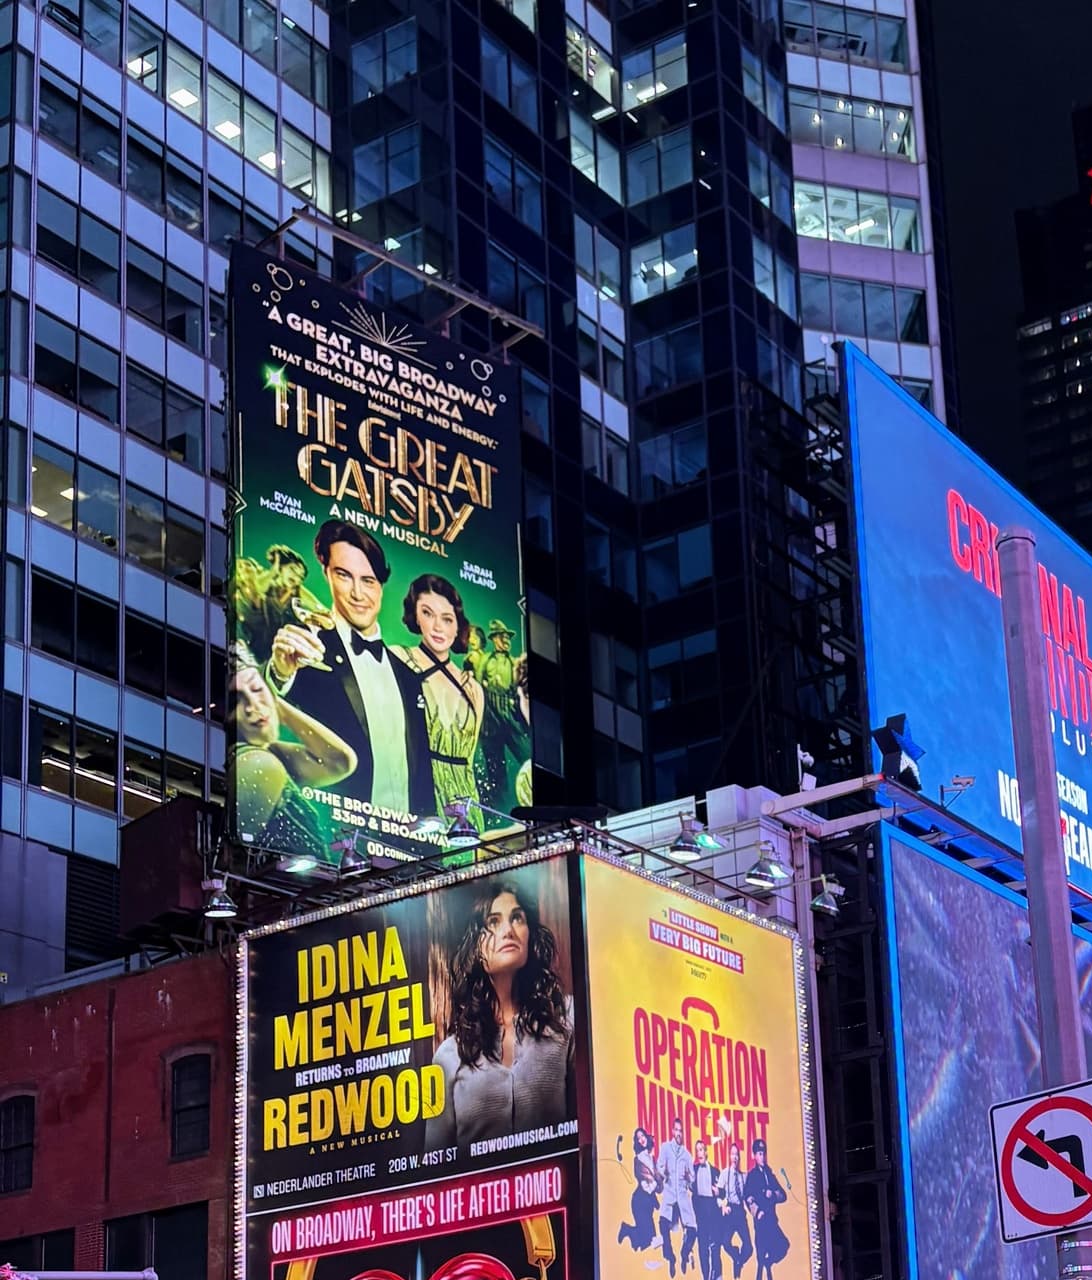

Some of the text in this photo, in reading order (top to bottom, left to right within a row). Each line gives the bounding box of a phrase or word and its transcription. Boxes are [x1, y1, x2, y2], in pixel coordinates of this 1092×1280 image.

[270, 345, 302, 367] THAT
[305, 360, 367, 395] EXPLODES
[368, 386, 399, 407] WITH
[401, 400, 424, 419] LIFE
[425, 412, 450, 430] AND
[286, 313, 355, 357] GREAT,
[360, 344, 394, 372] BIG
[398, 361, 497, 417] BROADWAY
[316, 344, 463, 422] EXTRAVAGANZA
[272, 380, 498, 509] THE GREAT
[260, 497, 315, 525] McCARTAN
[273, 490, 301, 509] RYAN
[297, 443, 474, 543] GATSBY
[329, 504, 449, 558] A NEW MUSICAL
[460, 569, 497, 590] HYLAND
[463, 561, 493, 579] SARAH
[313, 789, 418, 825] THE BROADWAY
[331, 808, 451, 848] 53RD & BROADWAY
[999, 770, 1021, 826] NO
[297, 926, 408, 1004] IDINA
[652, 923, 680, 947] VERY
[682, 934, 701, 956] BIG
[702, 941, 742, 971] FUTURE
[274, 982, 436, 1071] MENZEL
[634, 1007, 768, 1108] OPERATION
[295, 1064, 342, 1088] RETURNS
[355, 1048, 411, 1075] BROADWAY
[263, 1064, 446, 1152] REDWOOD
[266, 1120, 579, 1196] NEDERLANDER THEATRE 208 W. 41ST ST REDWOODMUSICAL.COM
[309, 1130, 401, 1155] A NEW MUSICAL
[271, 1166, 562, 1255] ON BROADWAY, THERE'S LIFE AFTER ROMEO
